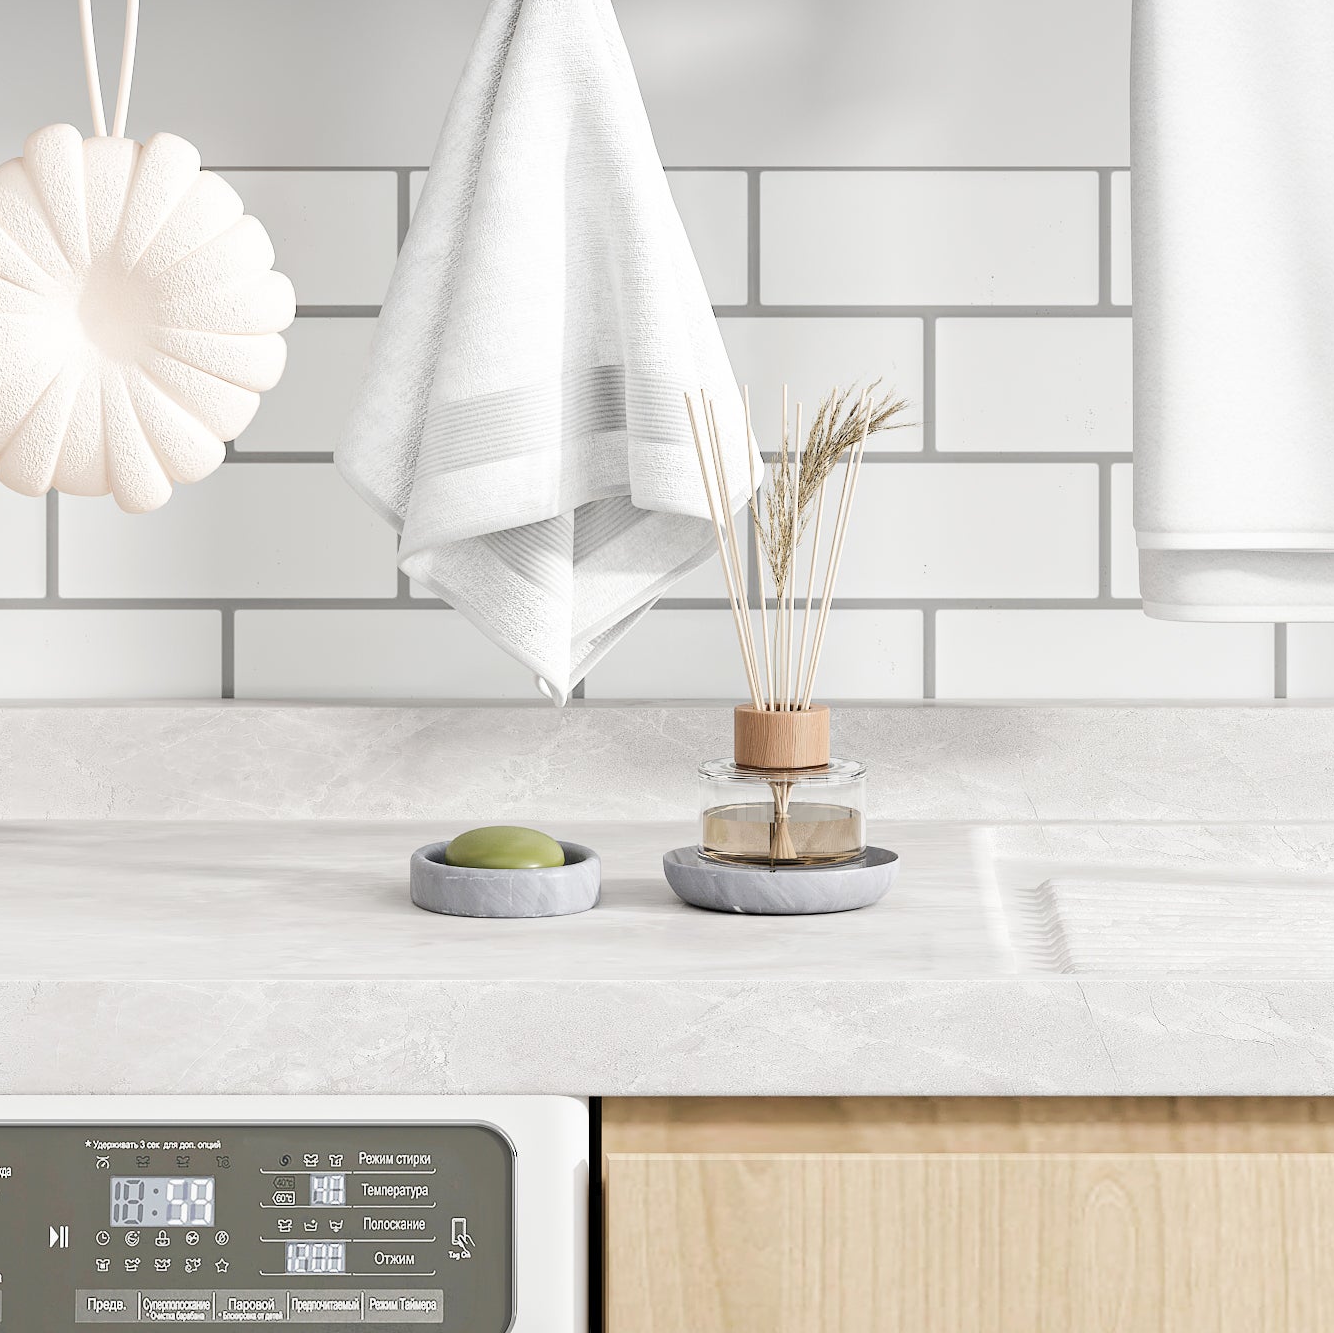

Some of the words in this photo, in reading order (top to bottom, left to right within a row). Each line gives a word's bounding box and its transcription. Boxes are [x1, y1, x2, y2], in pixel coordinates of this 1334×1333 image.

[140, 1140, 146, 1149] 3
[163, 1142, 178, 1150] для
[197, 1140, 221, 1150] опций
[358, 1152, 393, 1165] Режим
[396, 1153, 431, 1167] стирки
[361, 1183, 428, 1199] Температура
[363, 1217, 425, 1230] Полоскание
[374, 1251, 415, 1265] Отжим
[87, 1297, 127, 1313] Предв.
[143, 1297, 211, 1313] Суперполоскание
[228, 1297, 275, 1313] Паровой
[291, 1298, 360, 1312] Предпочитаемый
[369, 1298, 398, 1311] Режим
[399, 1298, 436, 1313] Таймера
